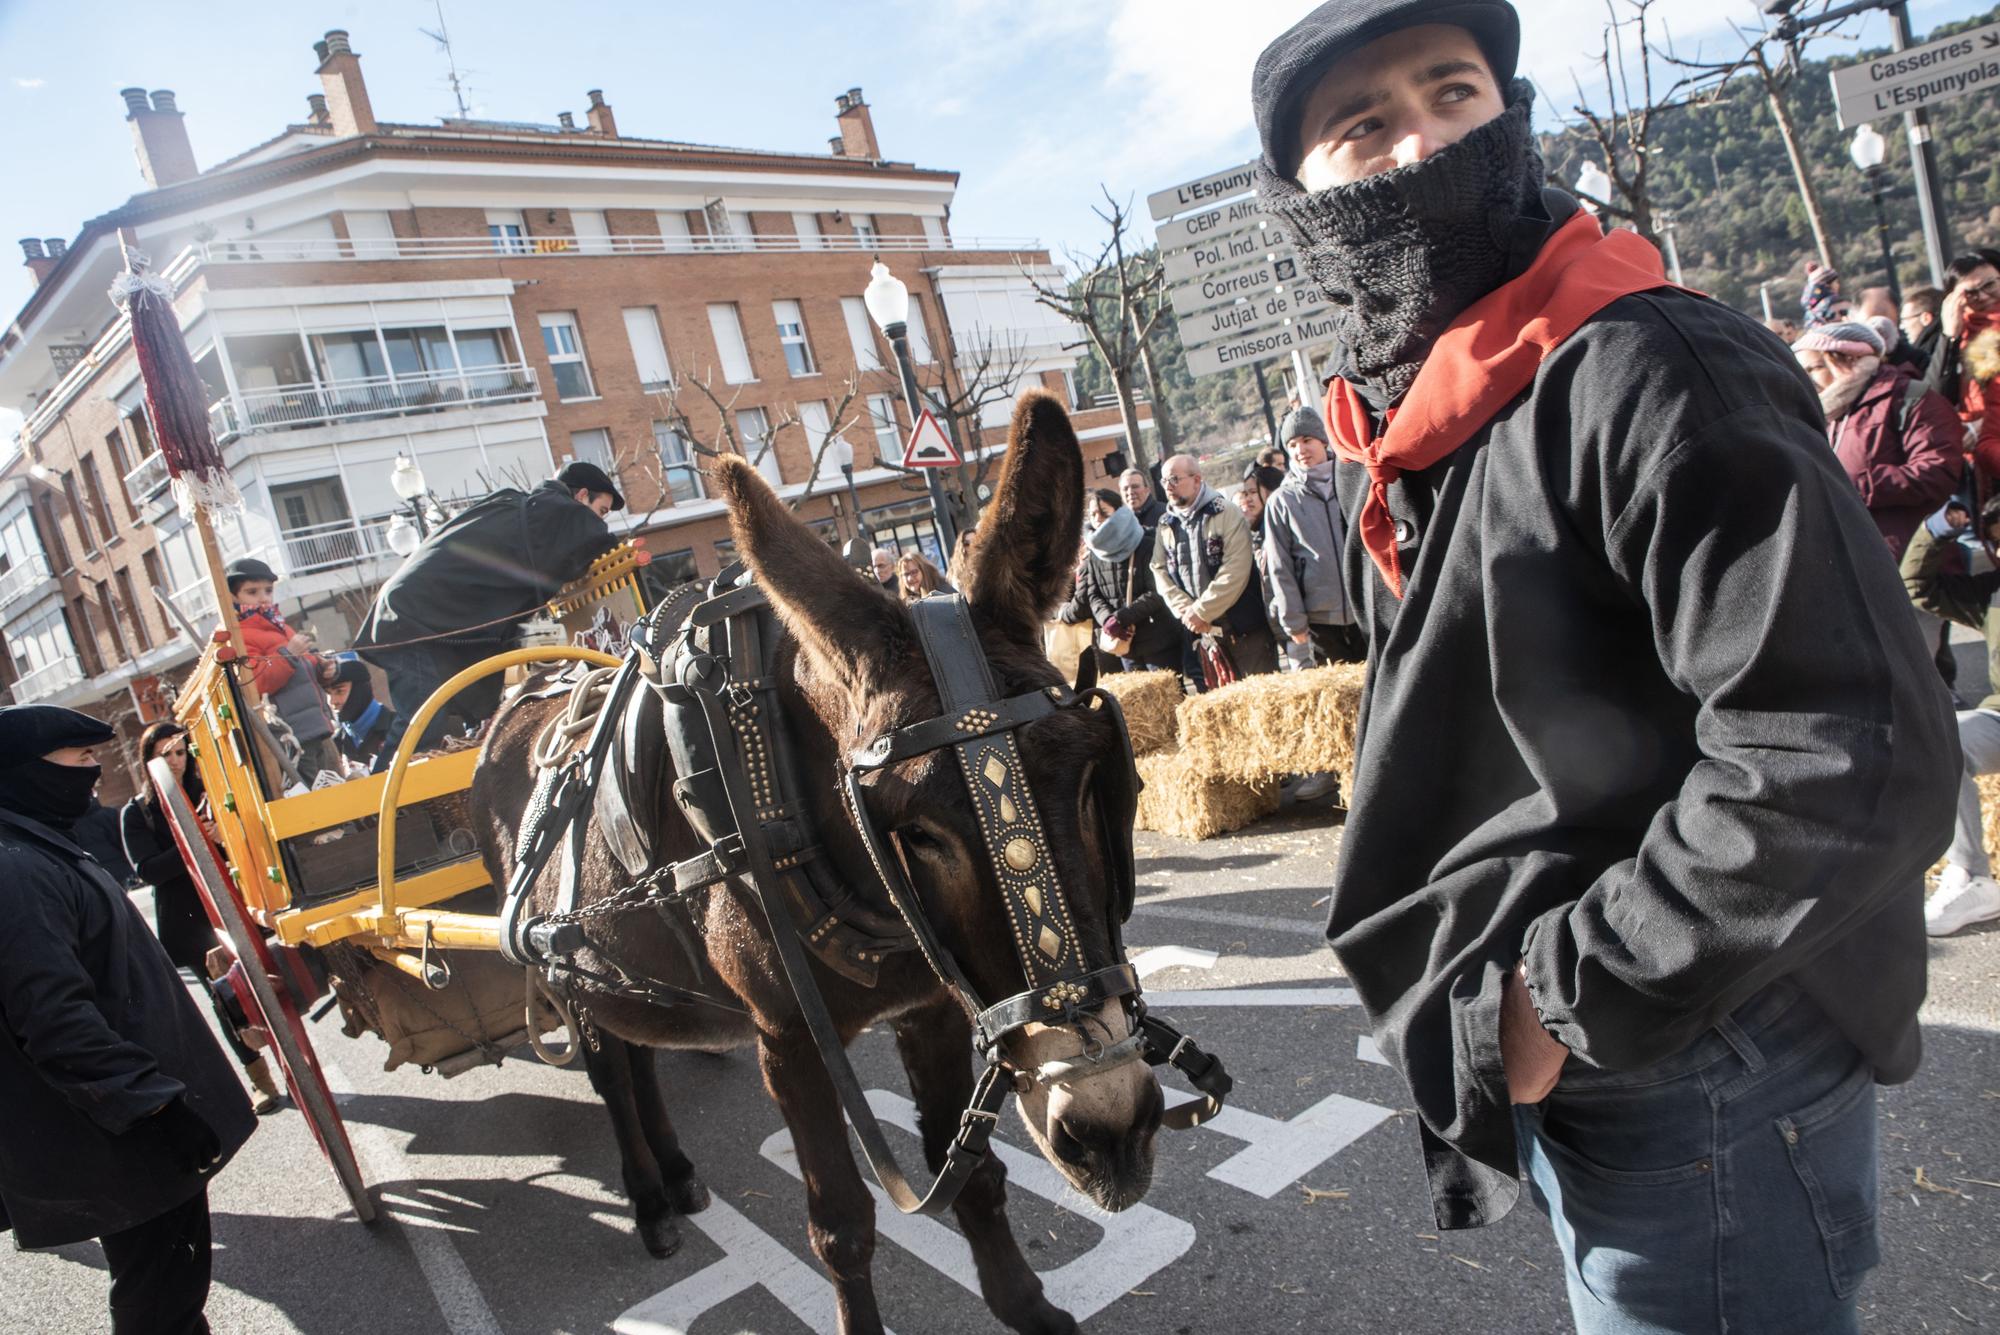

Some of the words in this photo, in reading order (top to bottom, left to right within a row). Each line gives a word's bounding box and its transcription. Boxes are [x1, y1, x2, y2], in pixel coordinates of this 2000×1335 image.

[1870, 38, 1973, 81] Casserres
[1874, 61, 1999, 111] L'Espunyola
[1186, 211, 1221, 235] CEIP
[1194, 246, 1226, 268] Pol.
[1228, 236, 1259, 258] Ind.
[1262, 231, 1285, 247] La
[1202, 270, 1270, 300] Correus
[1211, 306, 1259, 333] Jutjat
[1266, 298, 1288, 316] de
[1217, 332, 1294, 364] Emissora
